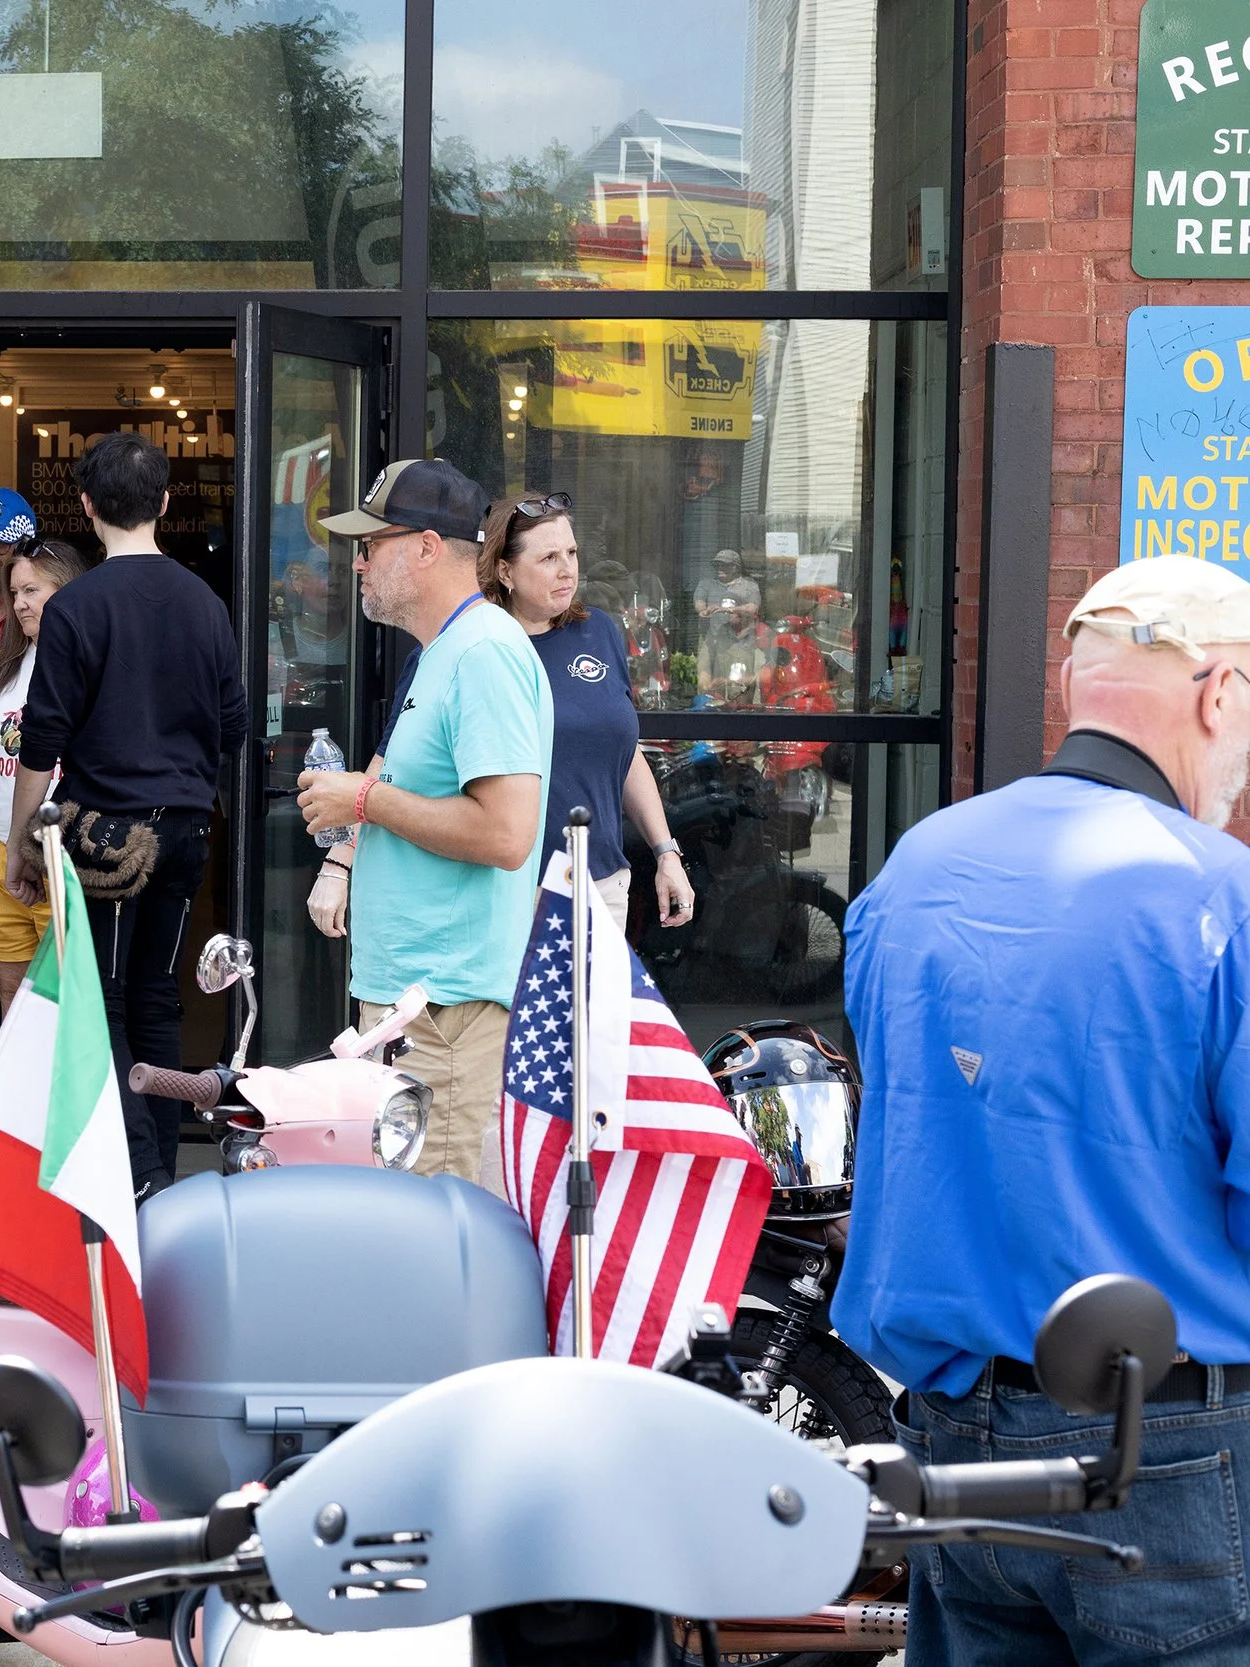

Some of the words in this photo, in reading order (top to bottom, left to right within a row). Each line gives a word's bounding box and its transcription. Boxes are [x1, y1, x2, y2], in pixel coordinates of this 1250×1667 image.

[1162, 36, 1250, 102] RE
[1213, 129, 1250, 154] ST
[31, 480, 66, 497] 900
[33, 500, 83, 515] double
[1134, 518, 1250, 561] INSPE
